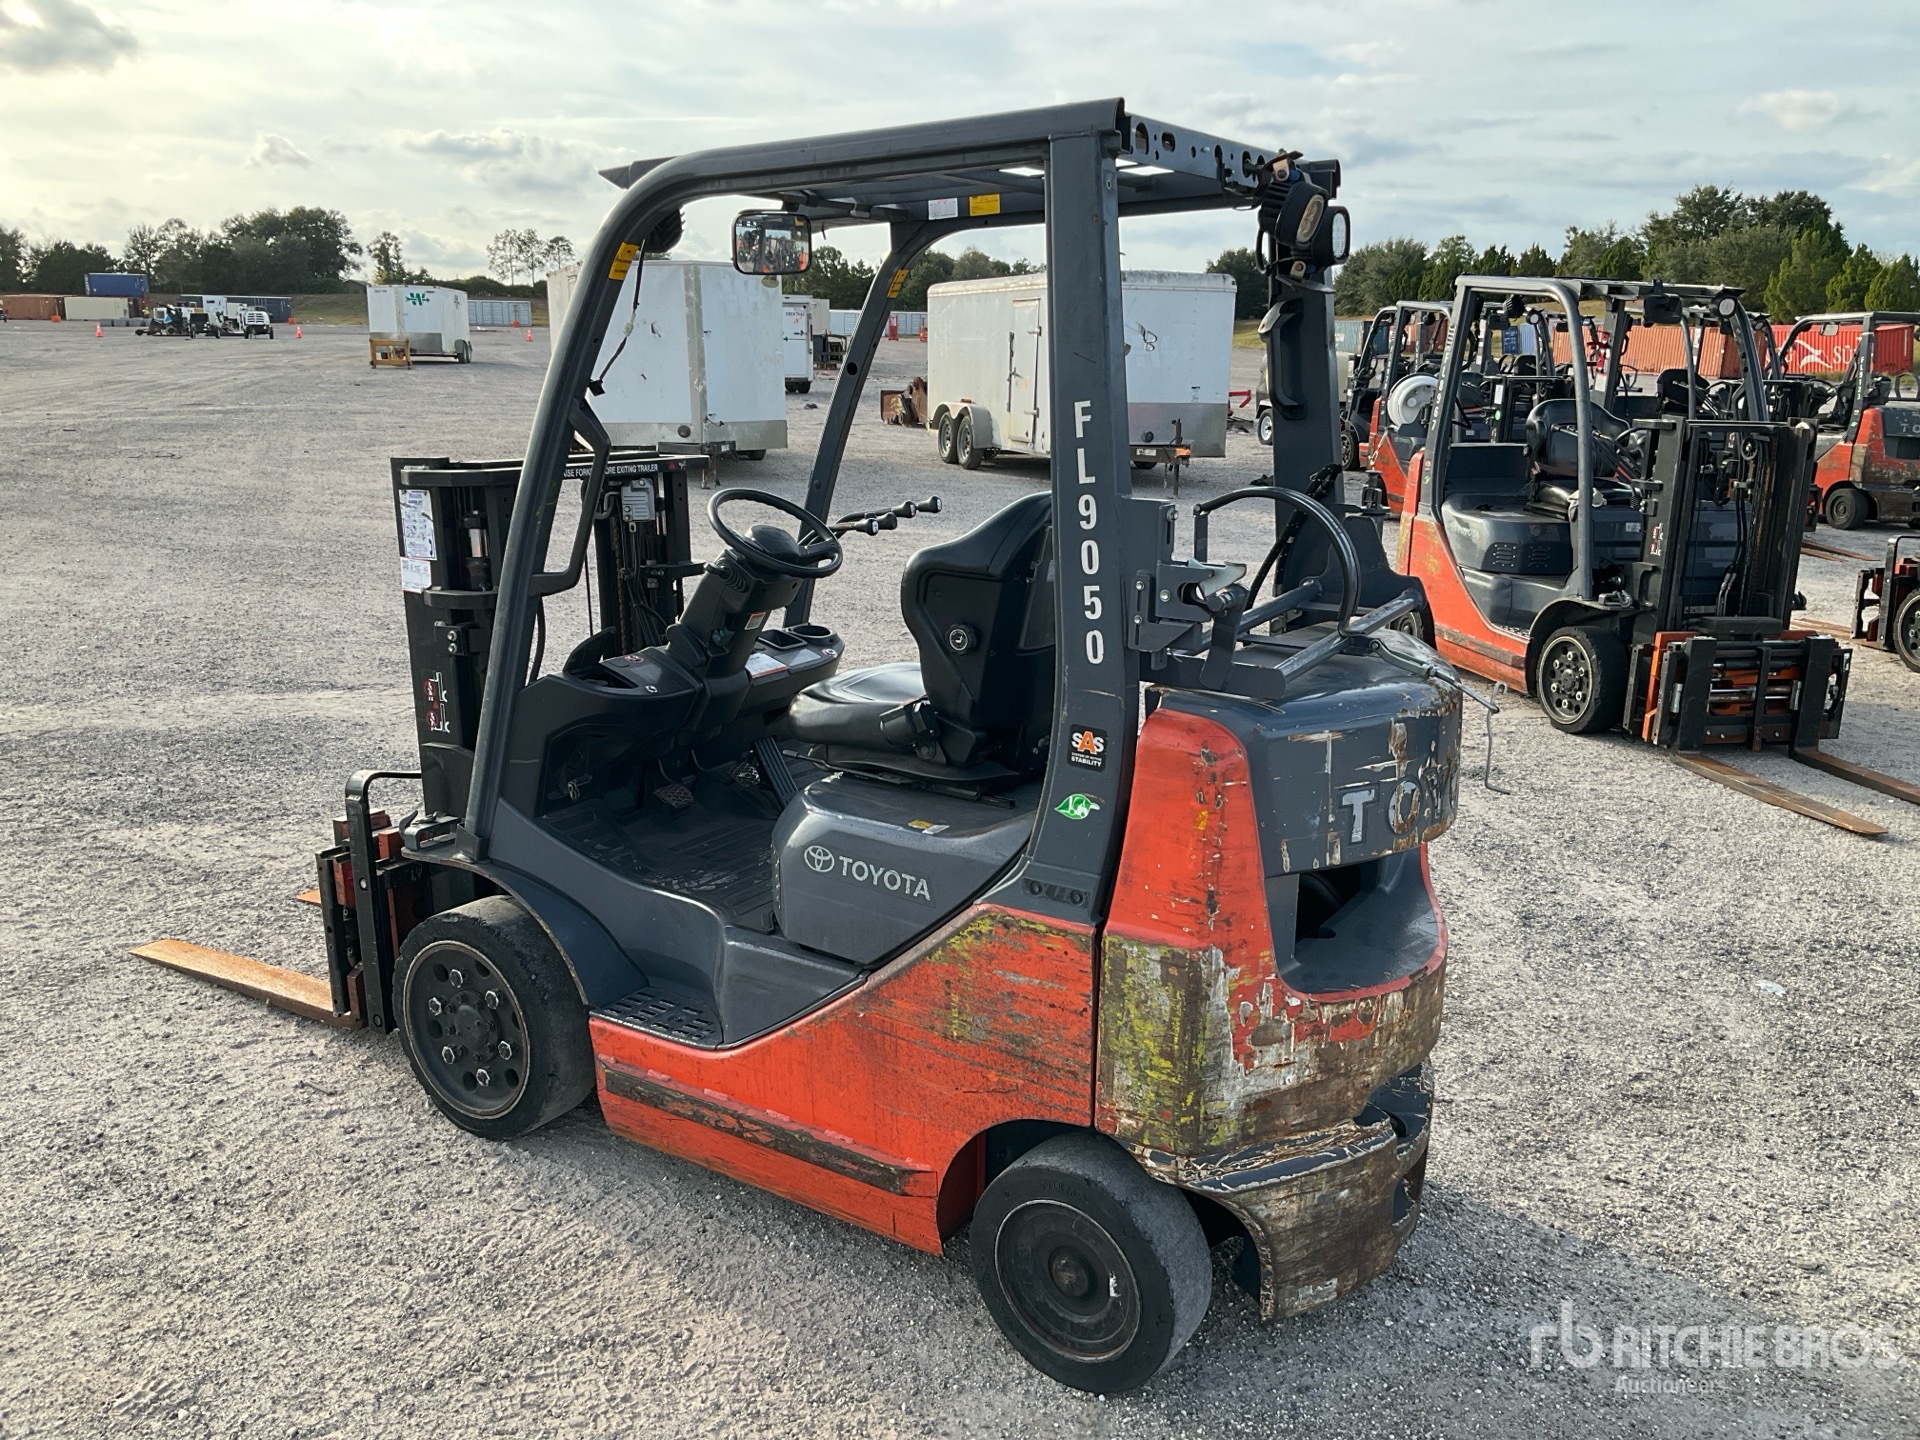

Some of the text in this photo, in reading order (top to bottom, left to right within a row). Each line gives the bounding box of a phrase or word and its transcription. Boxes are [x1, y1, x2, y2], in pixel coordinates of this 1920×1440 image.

[616, 464, 637, 474] EXITING
[637, 463, 658, 473] TRAILER
[1074, 400, 1105, 665] FL9050
[1072, 731, 1104, 755] SAS
[1071, 755, 1102, 767] STABILITY
[839, 855, 931, 901] TOYOTA
